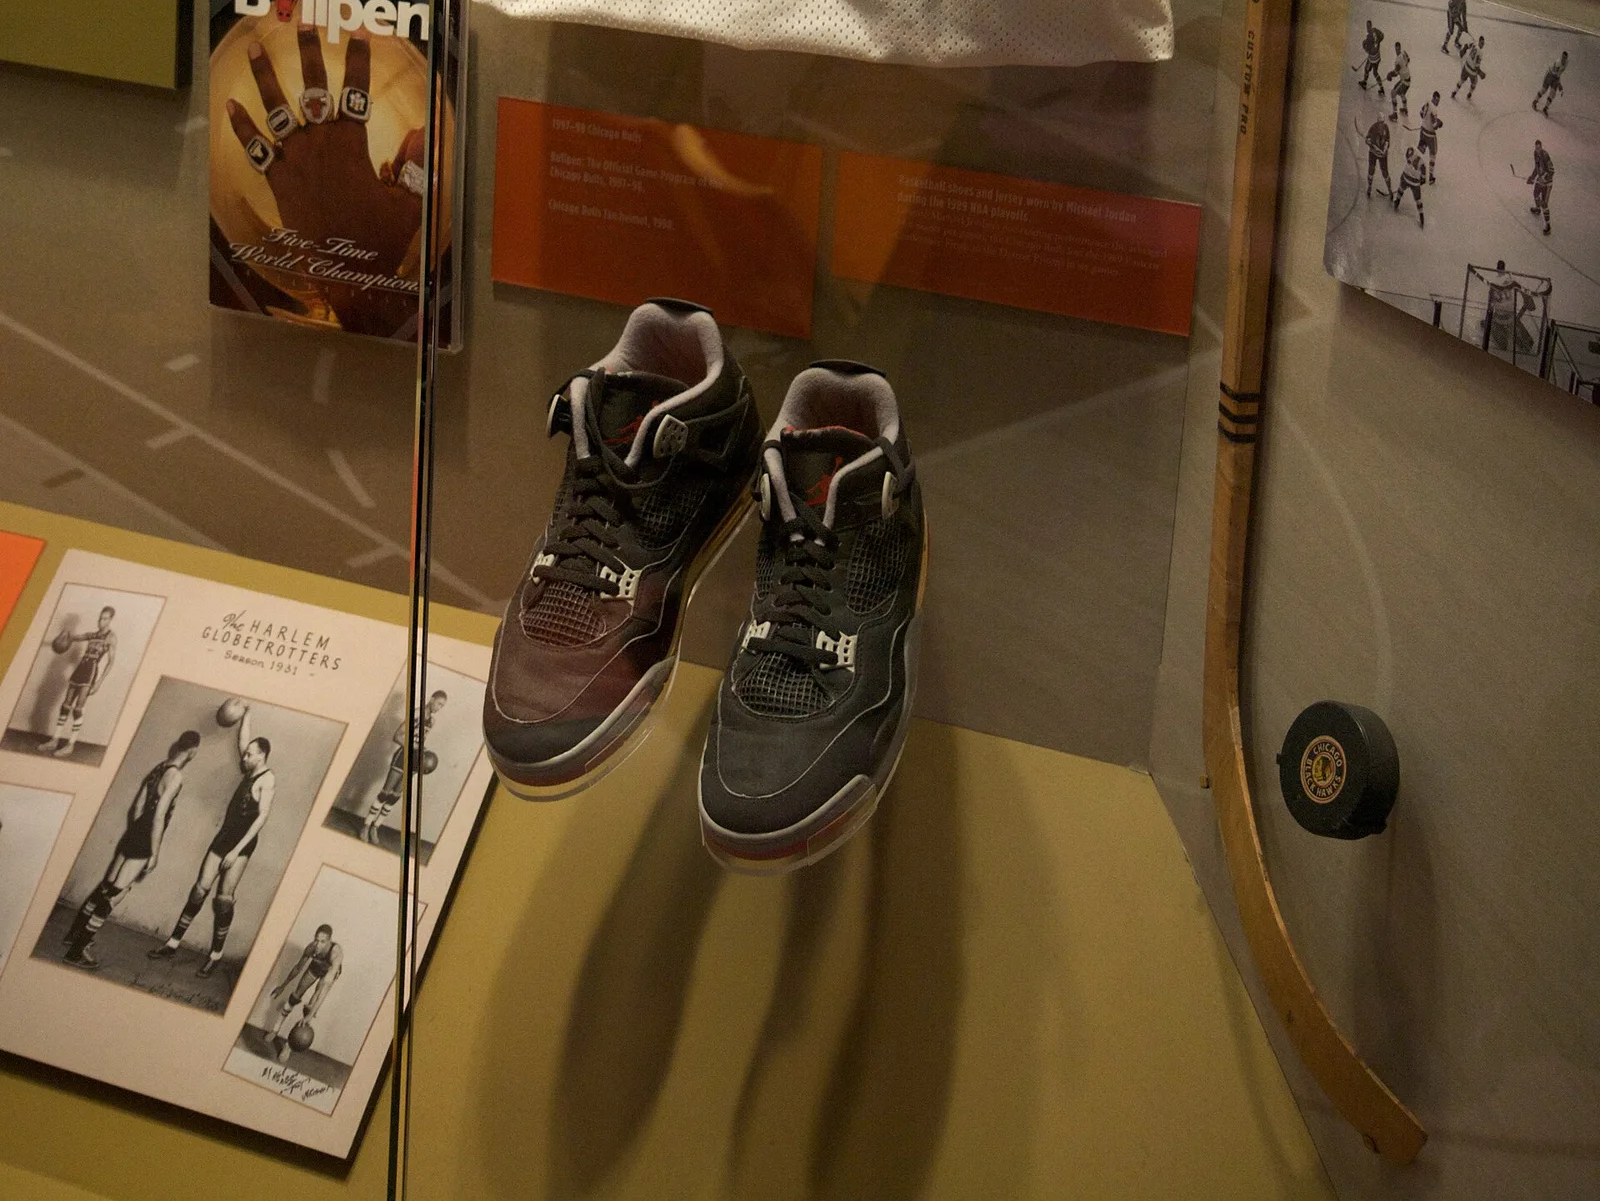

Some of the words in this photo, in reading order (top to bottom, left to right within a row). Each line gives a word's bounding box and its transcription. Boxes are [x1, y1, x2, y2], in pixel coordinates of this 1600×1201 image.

[1242, 29, 1256, 96] CUSTOM
[1239, 102, 1250, 136] PRO
[229, 242, 304, 271] World
[262, 226, 379, 261] Five-Time
[202, 626, 342, 670] GLOBETROTTERS
[250, 619, 331, 650] HARLEM
[224, 650, 265, 668] Season
[1313, 743, 1343, 767] CHICAGO
[1316, 775, 1341, 797] HAWKS
